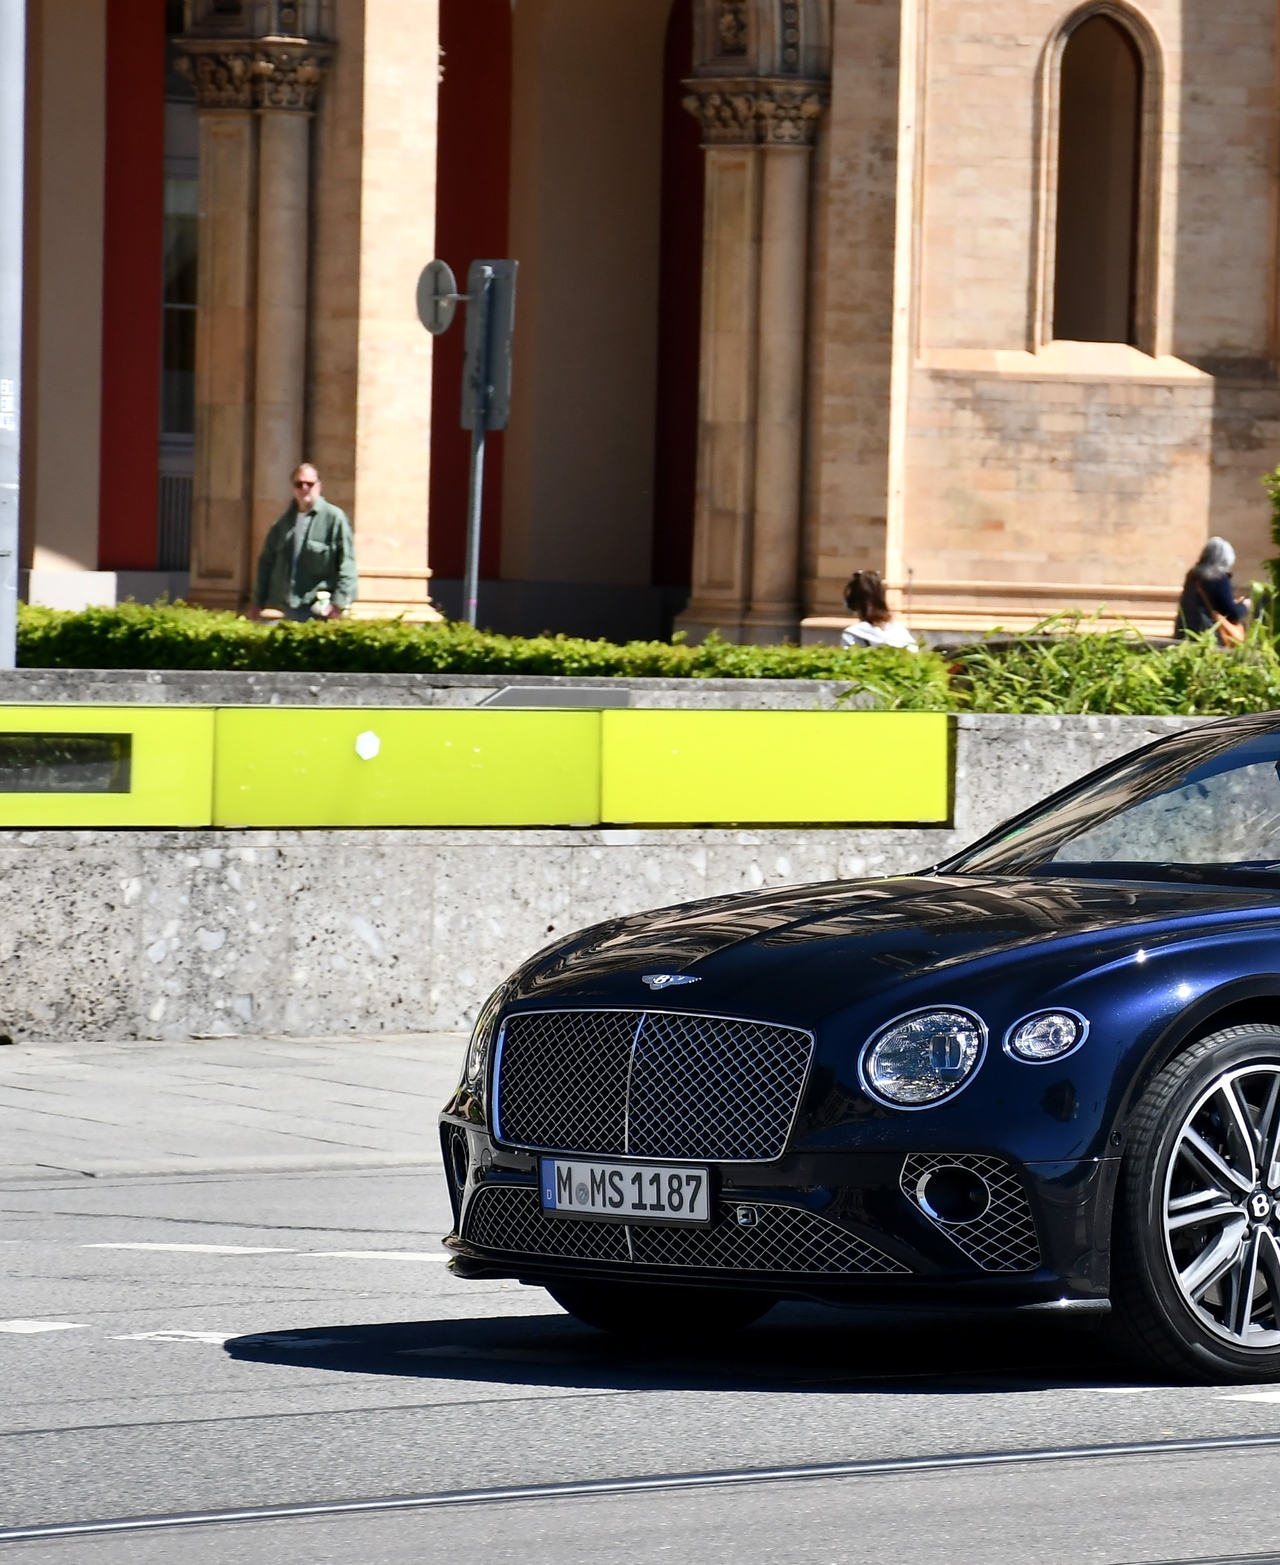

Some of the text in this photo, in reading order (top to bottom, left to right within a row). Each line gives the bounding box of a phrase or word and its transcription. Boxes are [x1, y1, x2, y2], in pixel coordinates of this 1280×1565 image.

[557, 1166, 702, 1213] M MS 1187
[1252, 1193, 1270, 1217] B
